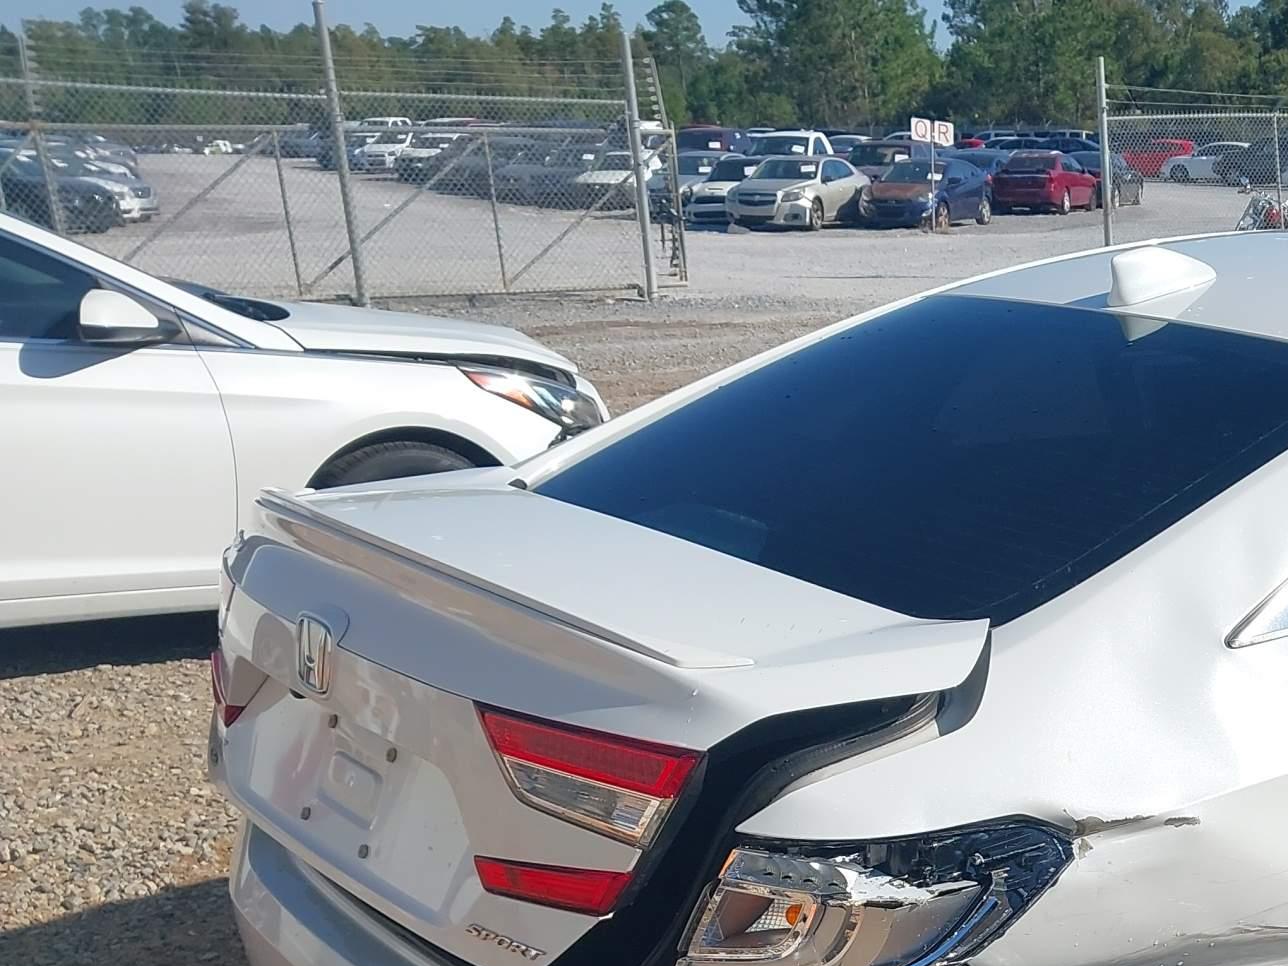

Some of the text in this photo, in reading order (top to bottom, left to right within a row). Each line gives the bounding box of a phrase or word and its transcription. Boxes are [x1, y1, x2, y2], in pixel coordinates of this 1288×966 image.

[915, 120, 928, 140] Q
[938, 123, 950, 143] R
[465, 923, 547, 960] SPORT
